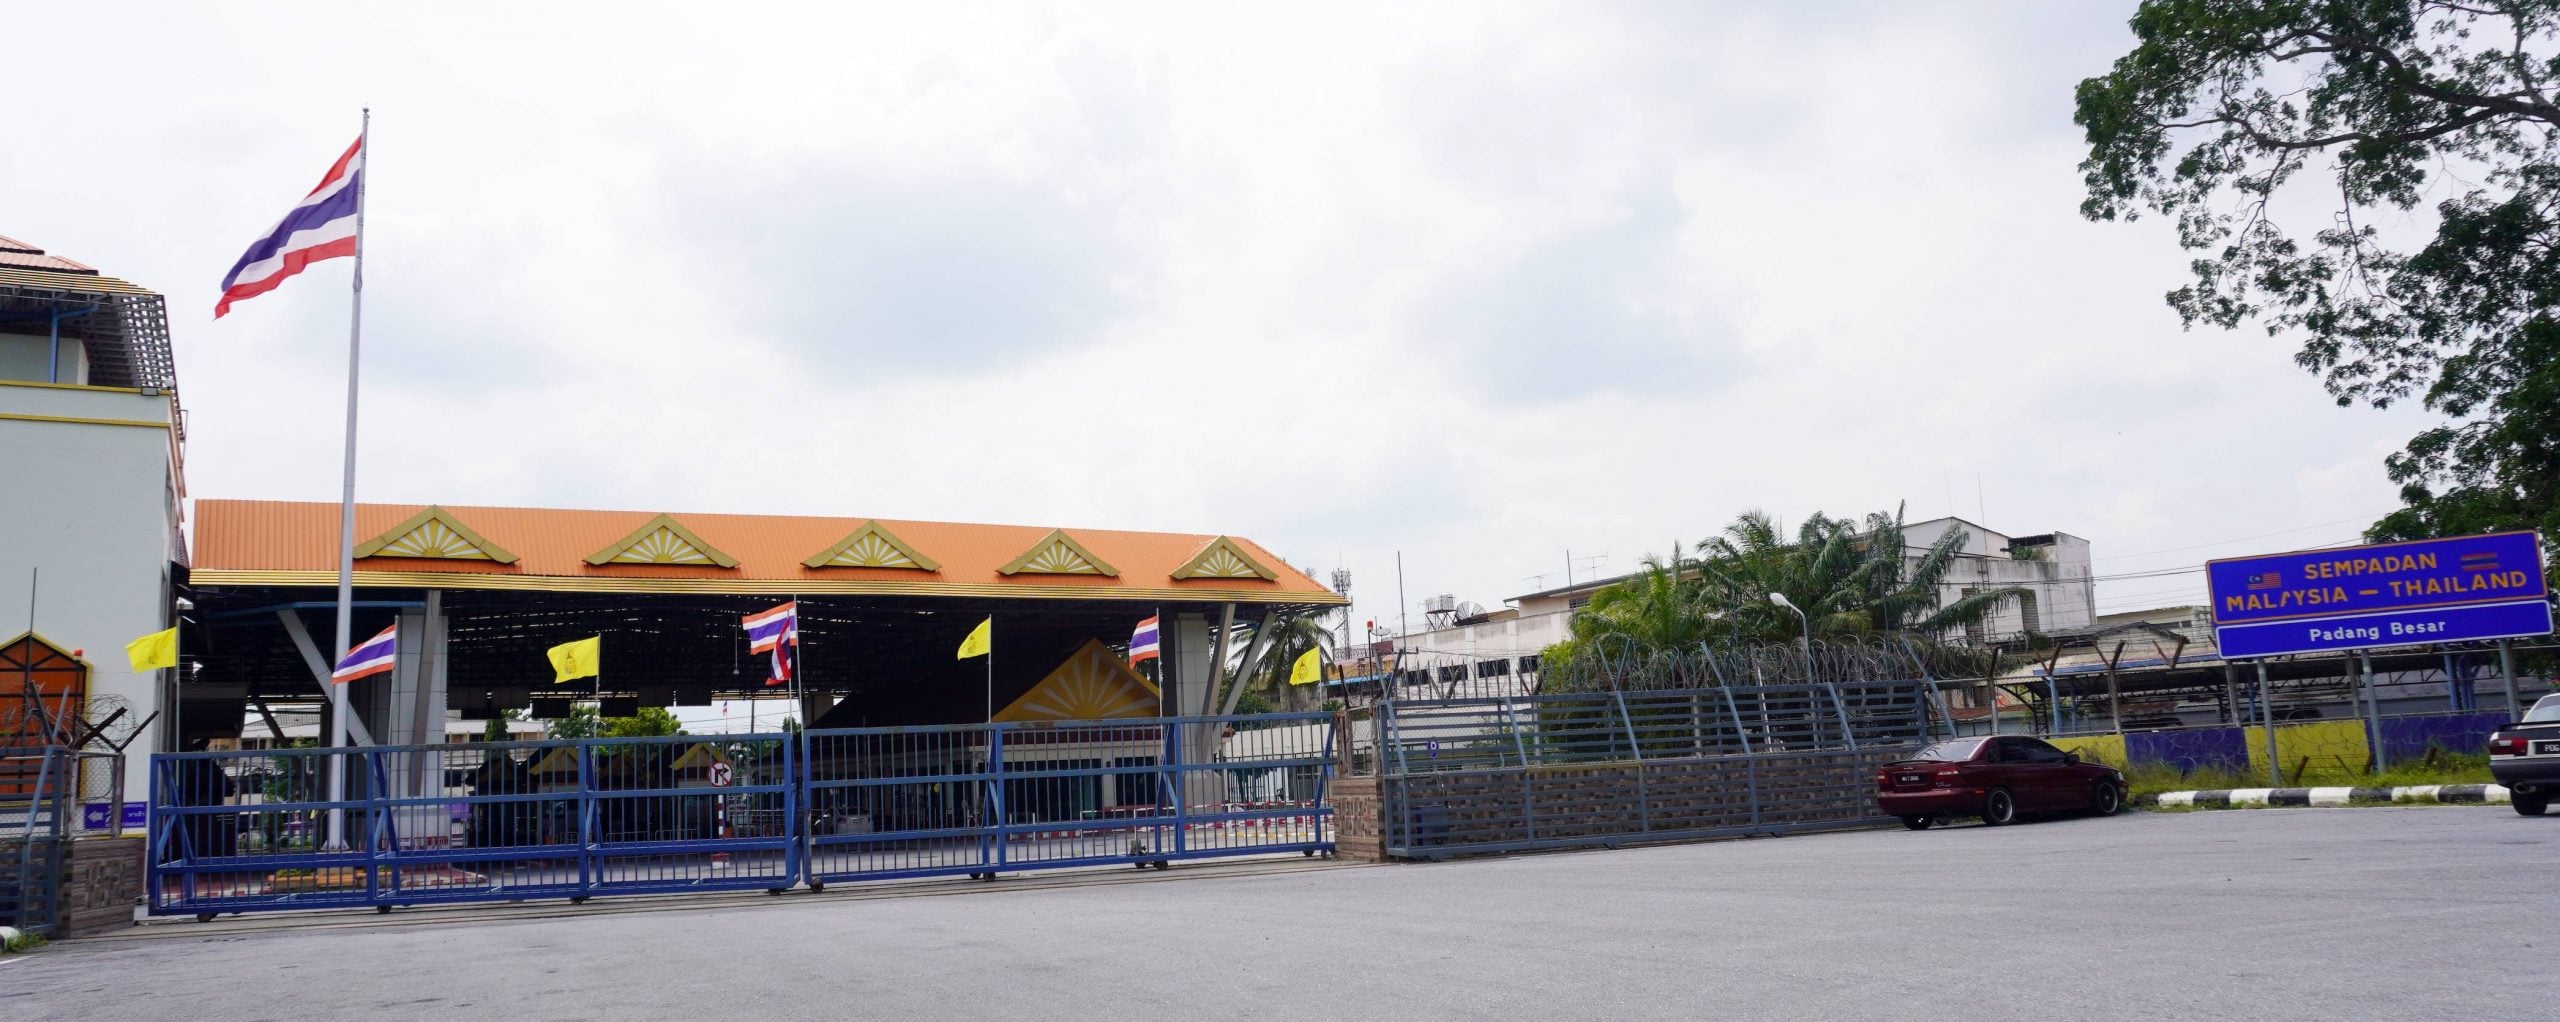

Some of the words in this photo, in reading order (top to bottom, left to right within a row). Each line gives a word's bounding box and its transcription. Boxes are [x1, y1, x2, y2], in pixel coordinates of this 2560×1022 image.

[2304, 553, 2438, 580] SEMPADAN
[2389, 570, 2527, 597] THAILAND
[2309, 626, 2380, 642] Padang
[2390, 621, 2446, 636] Besar
